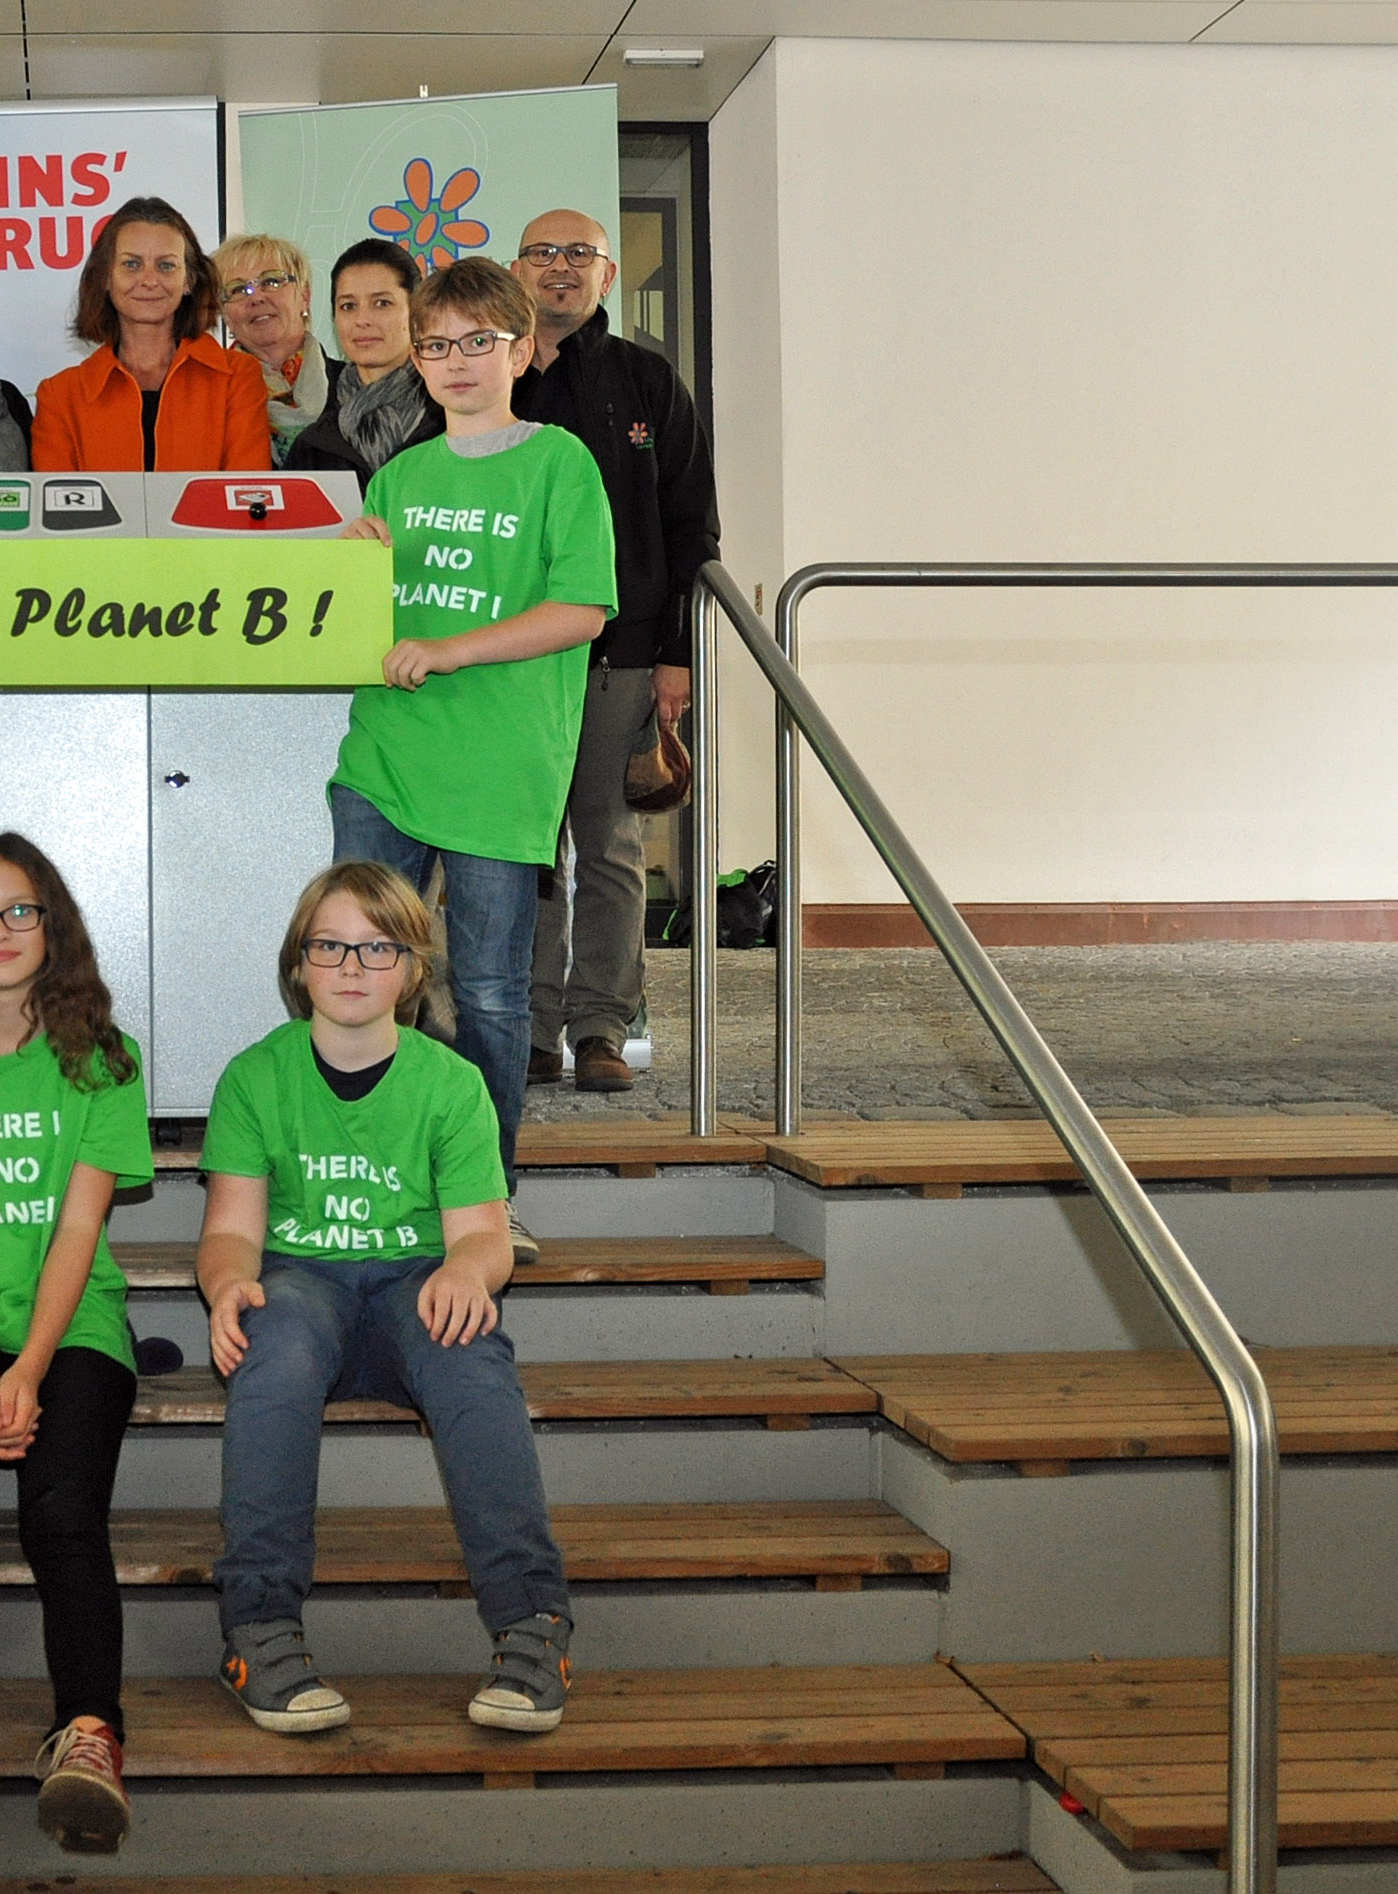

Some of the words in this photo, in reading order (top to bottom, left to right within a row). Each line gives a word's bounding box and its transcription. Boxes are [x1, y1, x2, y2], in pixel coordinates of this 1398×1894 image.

[64, 492, 86, 505] R
[403, 505, 486, 532] THERE
[491, 512, 519, 539] IS
[424, 544, 473, 570] NO
[10, 587, 221, 639] Planet
[242, 587, 289, 646] B
[309, 589, 334, 638] !
[324, 1194, 371, 1221] NO
[273, 1218, 385, 1250] PLANET
